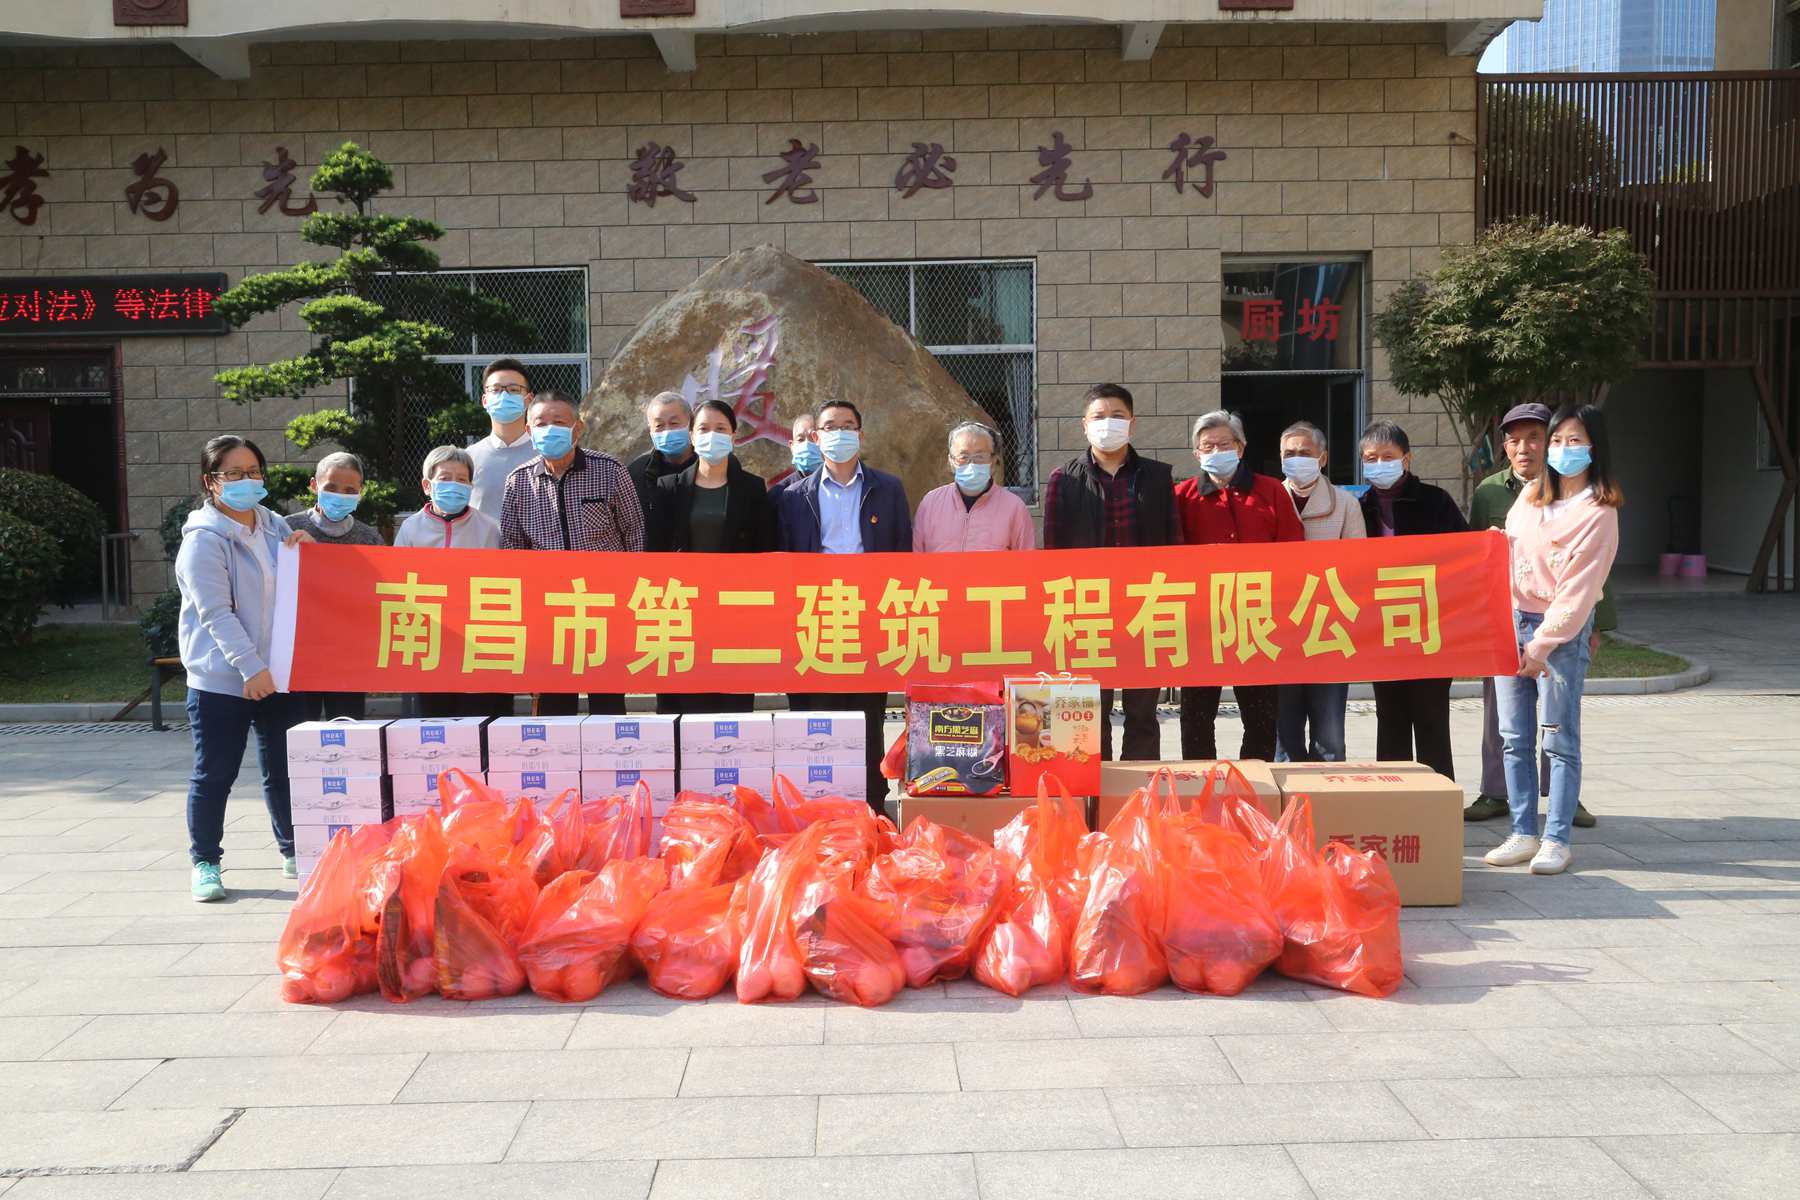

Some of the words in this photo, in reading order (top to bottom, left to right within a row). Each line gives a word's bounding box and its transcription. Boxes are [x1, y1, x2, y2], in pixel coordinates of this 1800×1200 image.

[626, 131, 1227, 209] 敬老必先行
[1241, 297, 1344, 342] 厨坊
[375, 563, 1442, 677] 南昌市第二建筑工程有限公司
[935, 745, 978, 757] 黑芝麻糊
